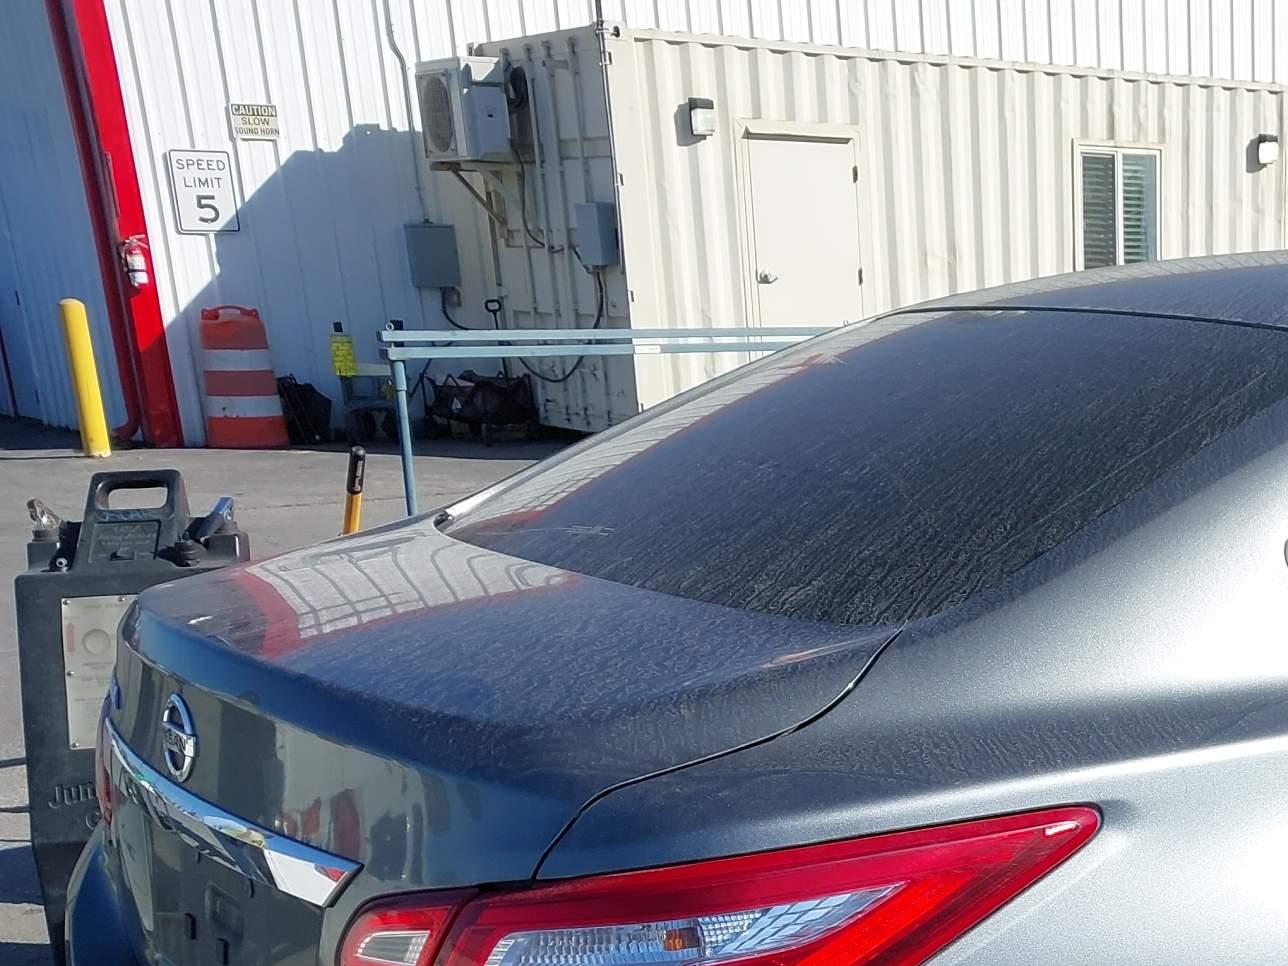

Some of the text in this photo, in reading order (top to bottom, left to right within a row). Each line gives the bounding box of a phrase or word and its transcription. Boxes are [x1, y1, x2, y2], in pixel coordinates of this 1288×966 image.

[232, 105, 276, 116] CAUTION
[241, 117, 270, 125] SLOW
[260, 128, 280, 136] HORN
[176, 158, 226, 171] SPEED
[184, 176, 222, 189] LIMIT
[196, 194, 220, 224] 5
